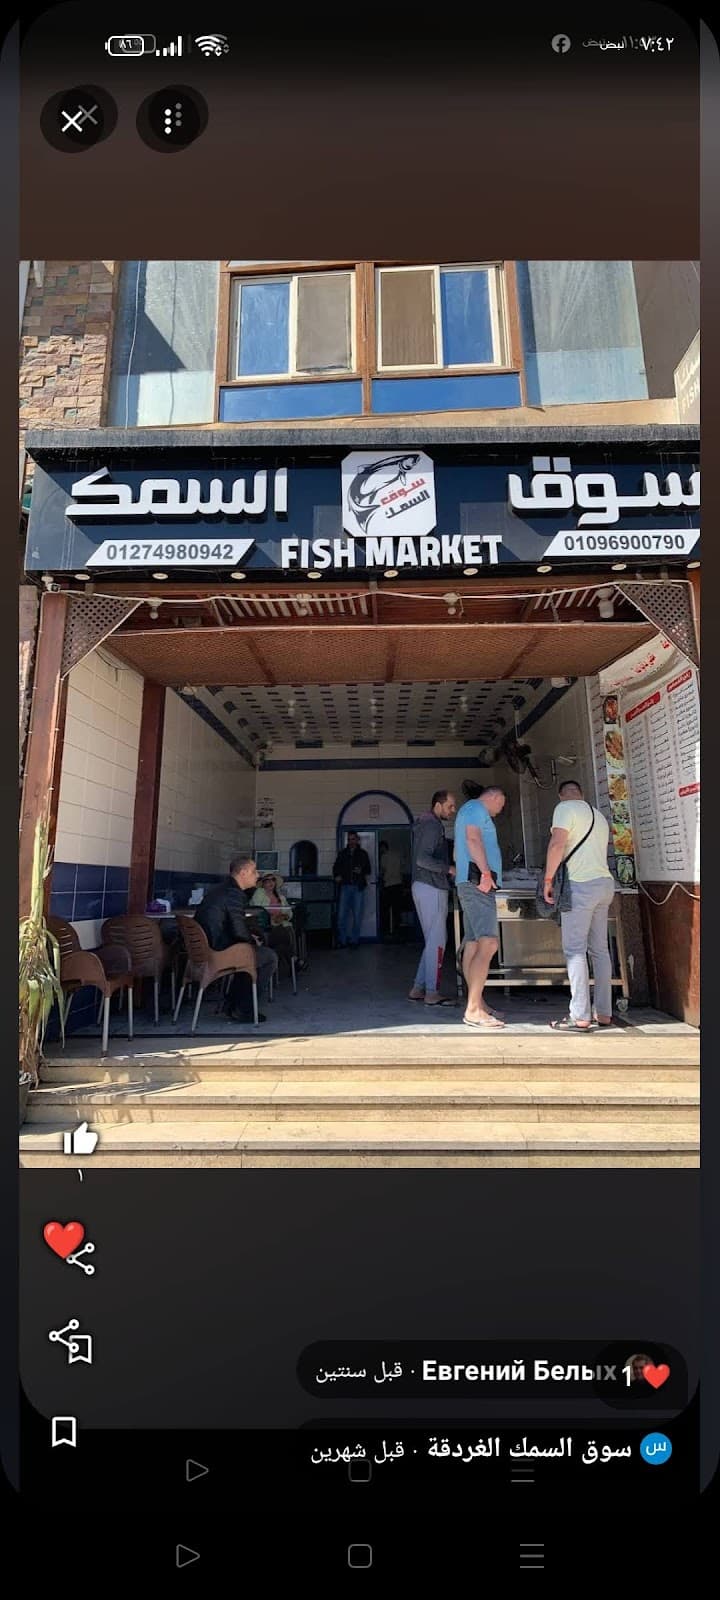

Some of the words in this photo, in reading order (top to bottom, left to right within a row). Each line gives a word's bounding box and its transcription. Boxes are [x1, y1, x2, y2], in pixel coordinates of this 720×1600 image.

[65, 466, 288, 516] السمك
[380, 478, 426, 506] سوق
[385, 489, 431, 519] السمك
[508, 456, 700, 527] سوق
[106, 543, 235, 561] 01274980942
[281, 538, 355, 568] FISH
[366, 535, 502, 566] MARKET
[564, 534, 686, 552] 01096900790
